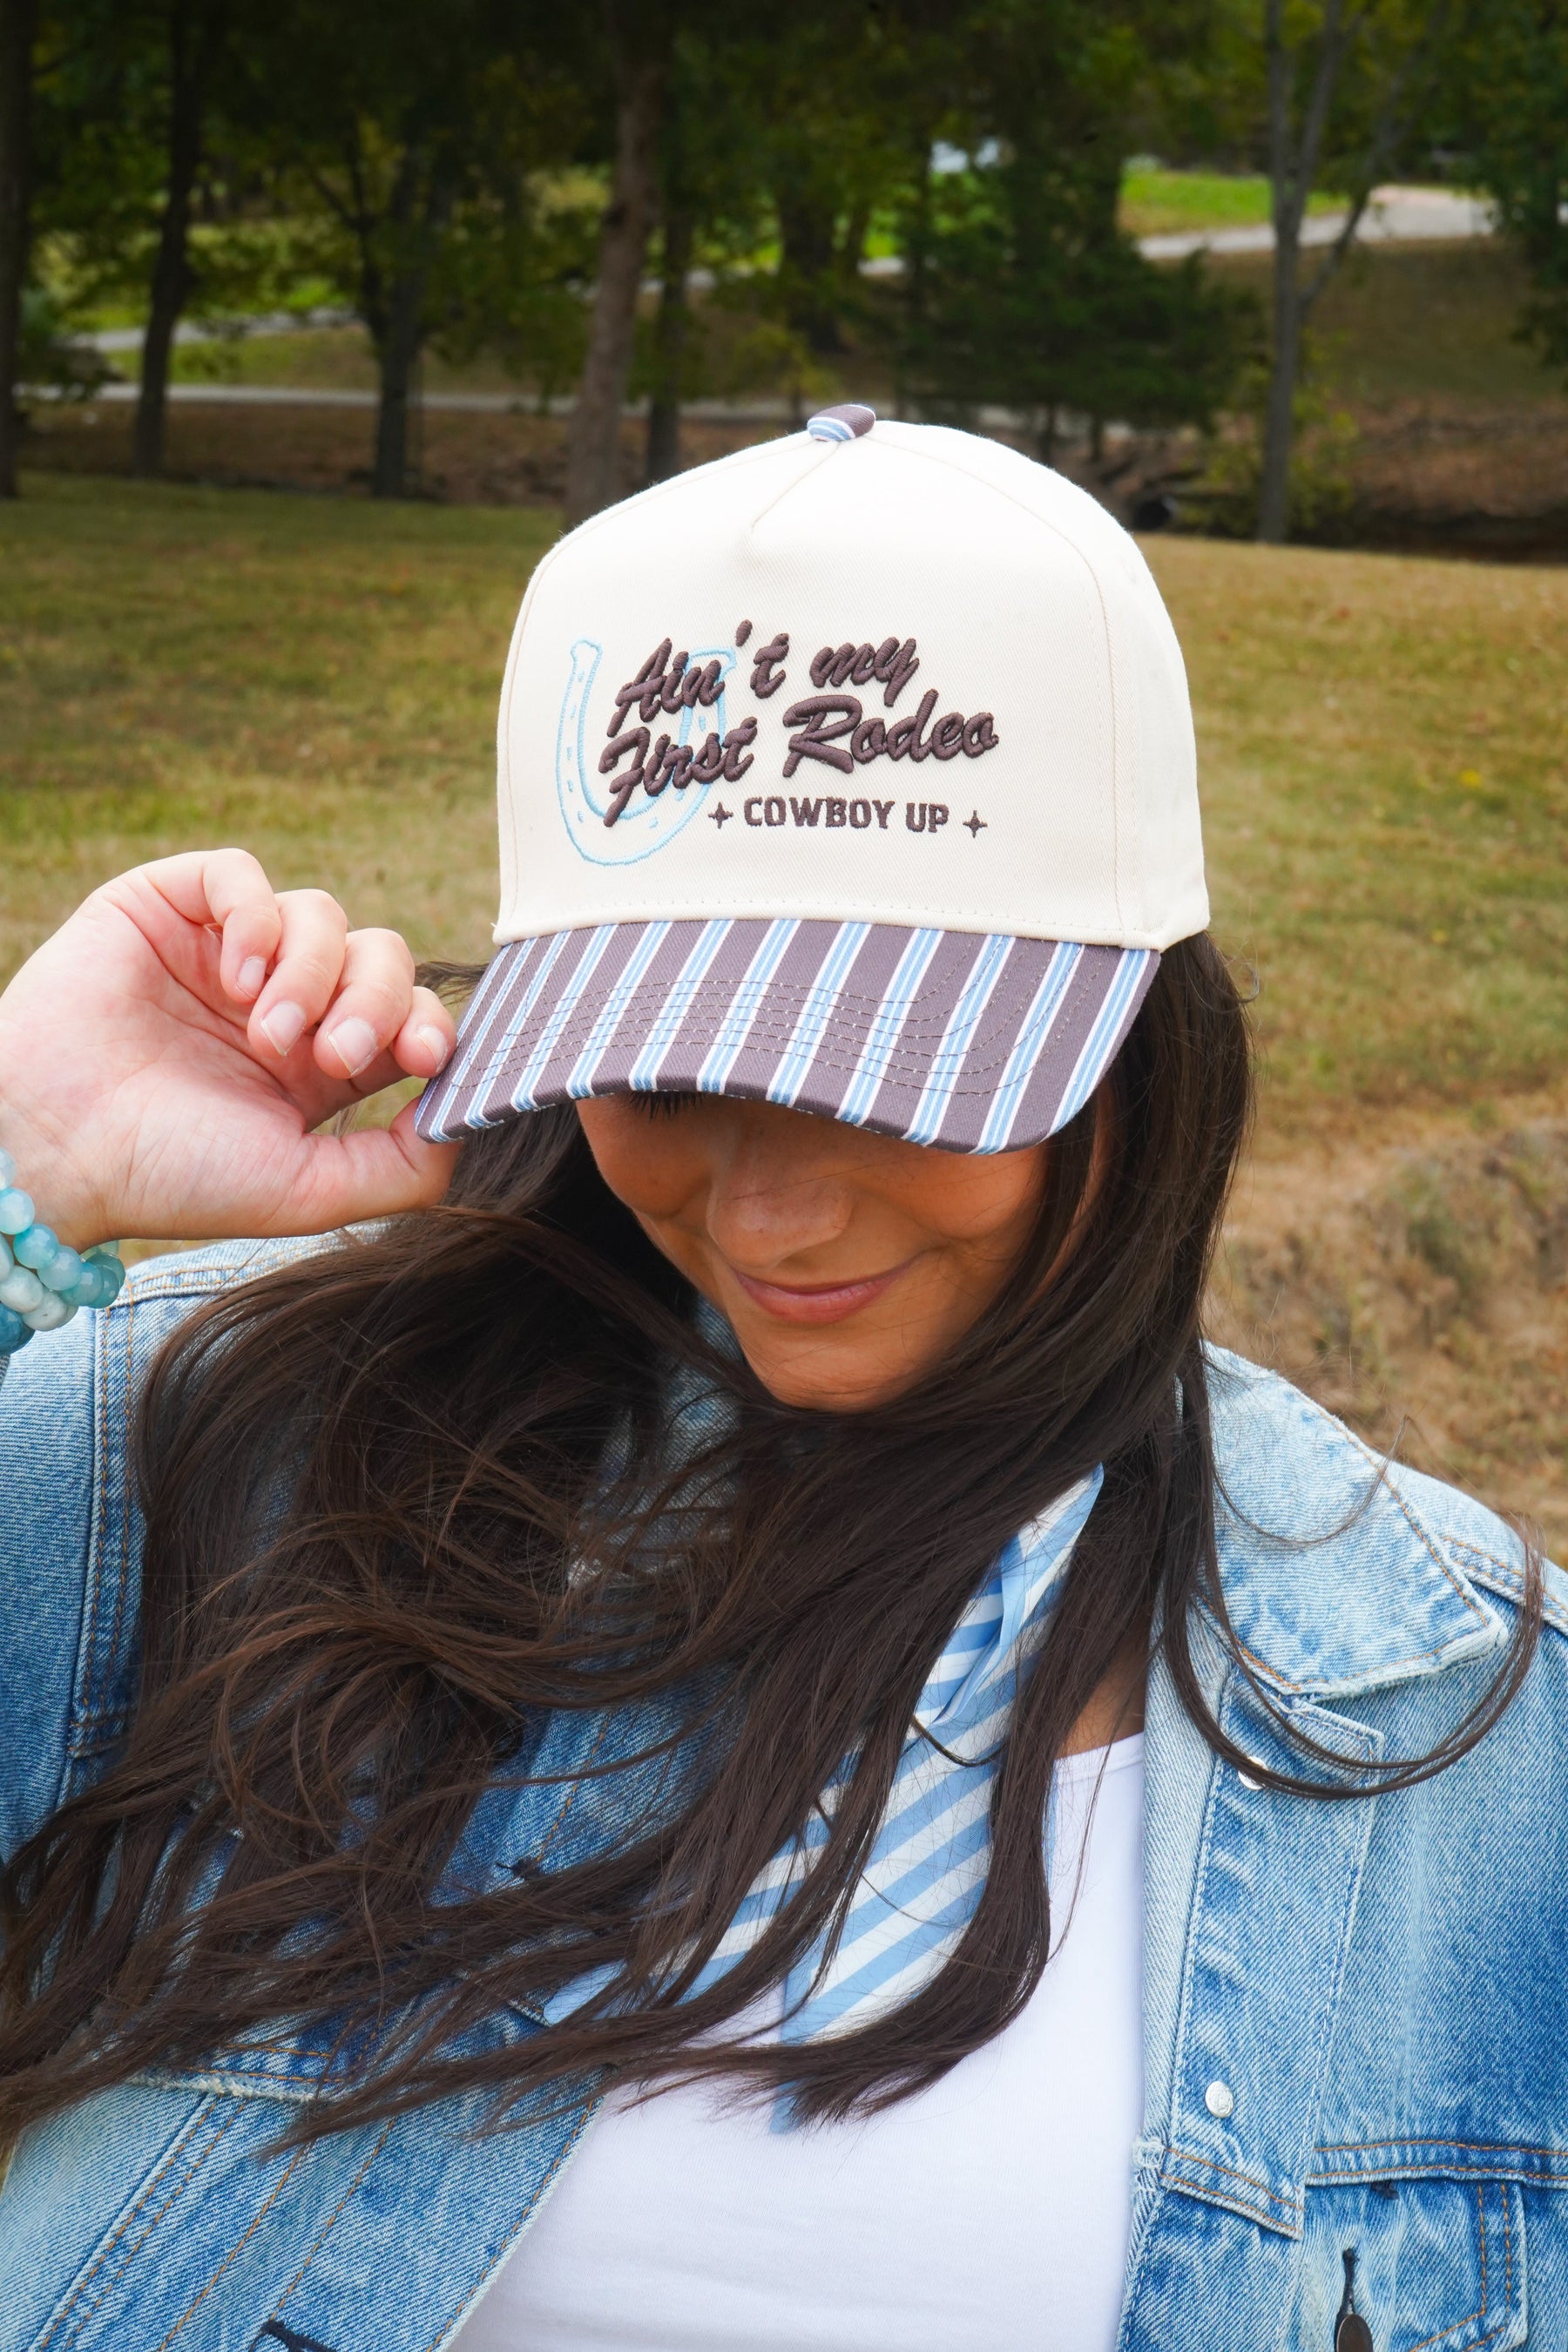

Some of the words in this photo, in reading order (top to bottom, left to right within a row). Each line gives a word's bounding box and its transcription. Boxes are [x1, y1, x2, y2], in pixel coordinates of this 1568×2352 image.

[606, 619, 789, 737] Ain't
[809, 637, 920, 707] my
[598, 716, 758, 827] First
[783, 688, 999, 778] Rodeo
[744, 796, 896, 830] COWBOY
[905, 800, 950, 833] UP
